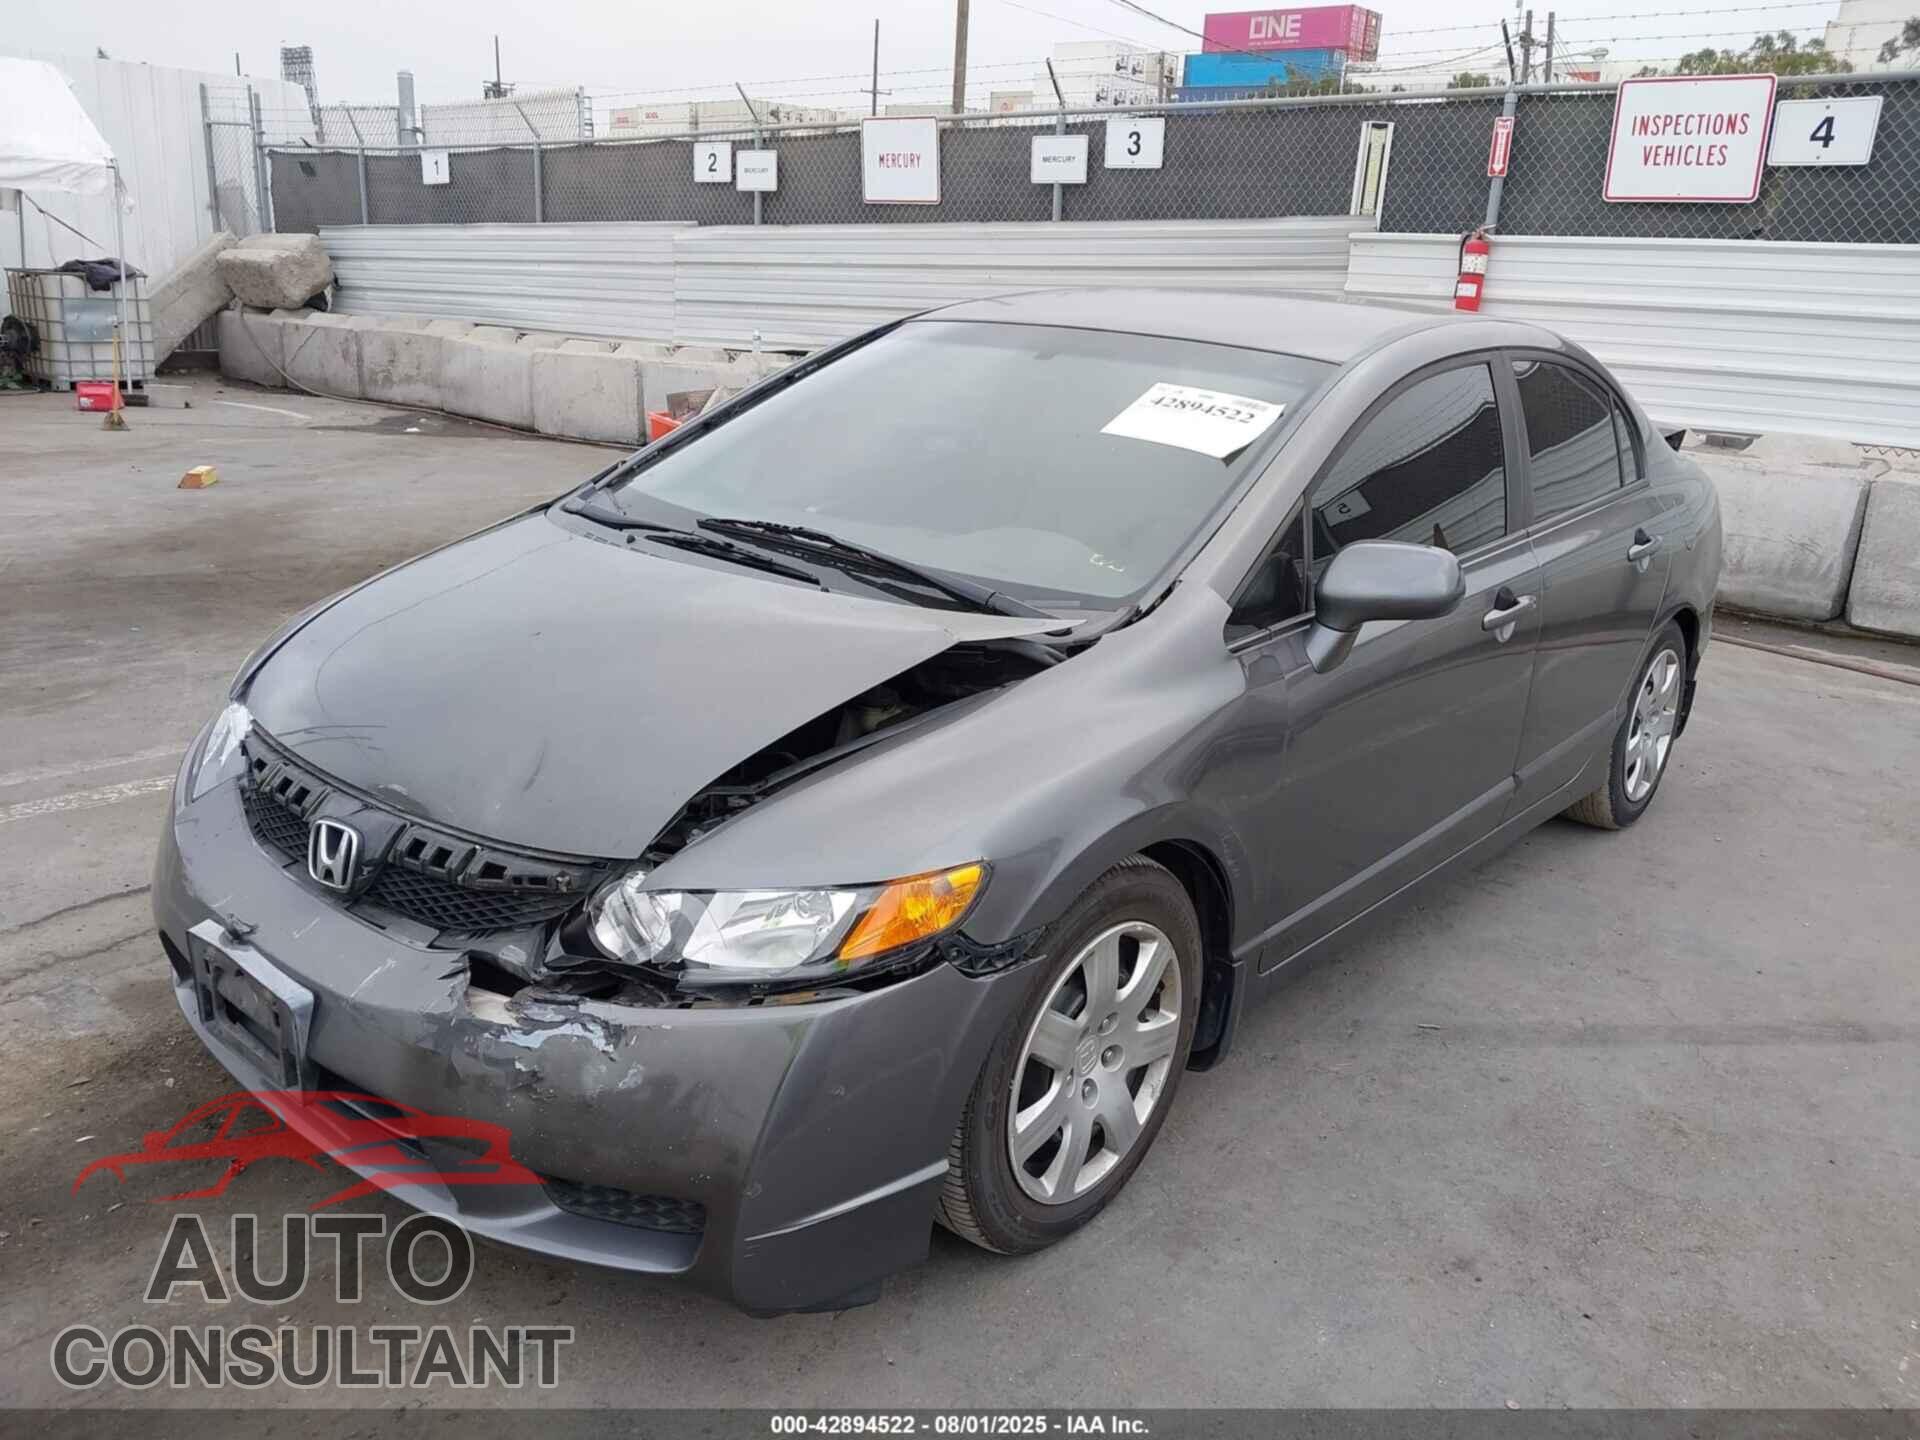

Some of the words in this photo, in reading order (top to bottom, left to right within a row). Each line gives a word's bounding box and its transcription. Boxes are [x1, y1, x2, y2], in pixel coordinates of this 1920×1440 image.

[1249, 14, 1302, 39] ONE
[1632, 113, 1751, 136] INSPECTIONS
[1809, 116, 1836, 148] 4
[1127, 131, 1142, 156] 3
[1643, 144, 1728, 166] VEHICLES
[434, 159, 439, 177] 1
[707, 152, 718, 173] 2
[879, 152, 921, 169] MERCURY
[1151, 396, 1256, 424] 42894522
